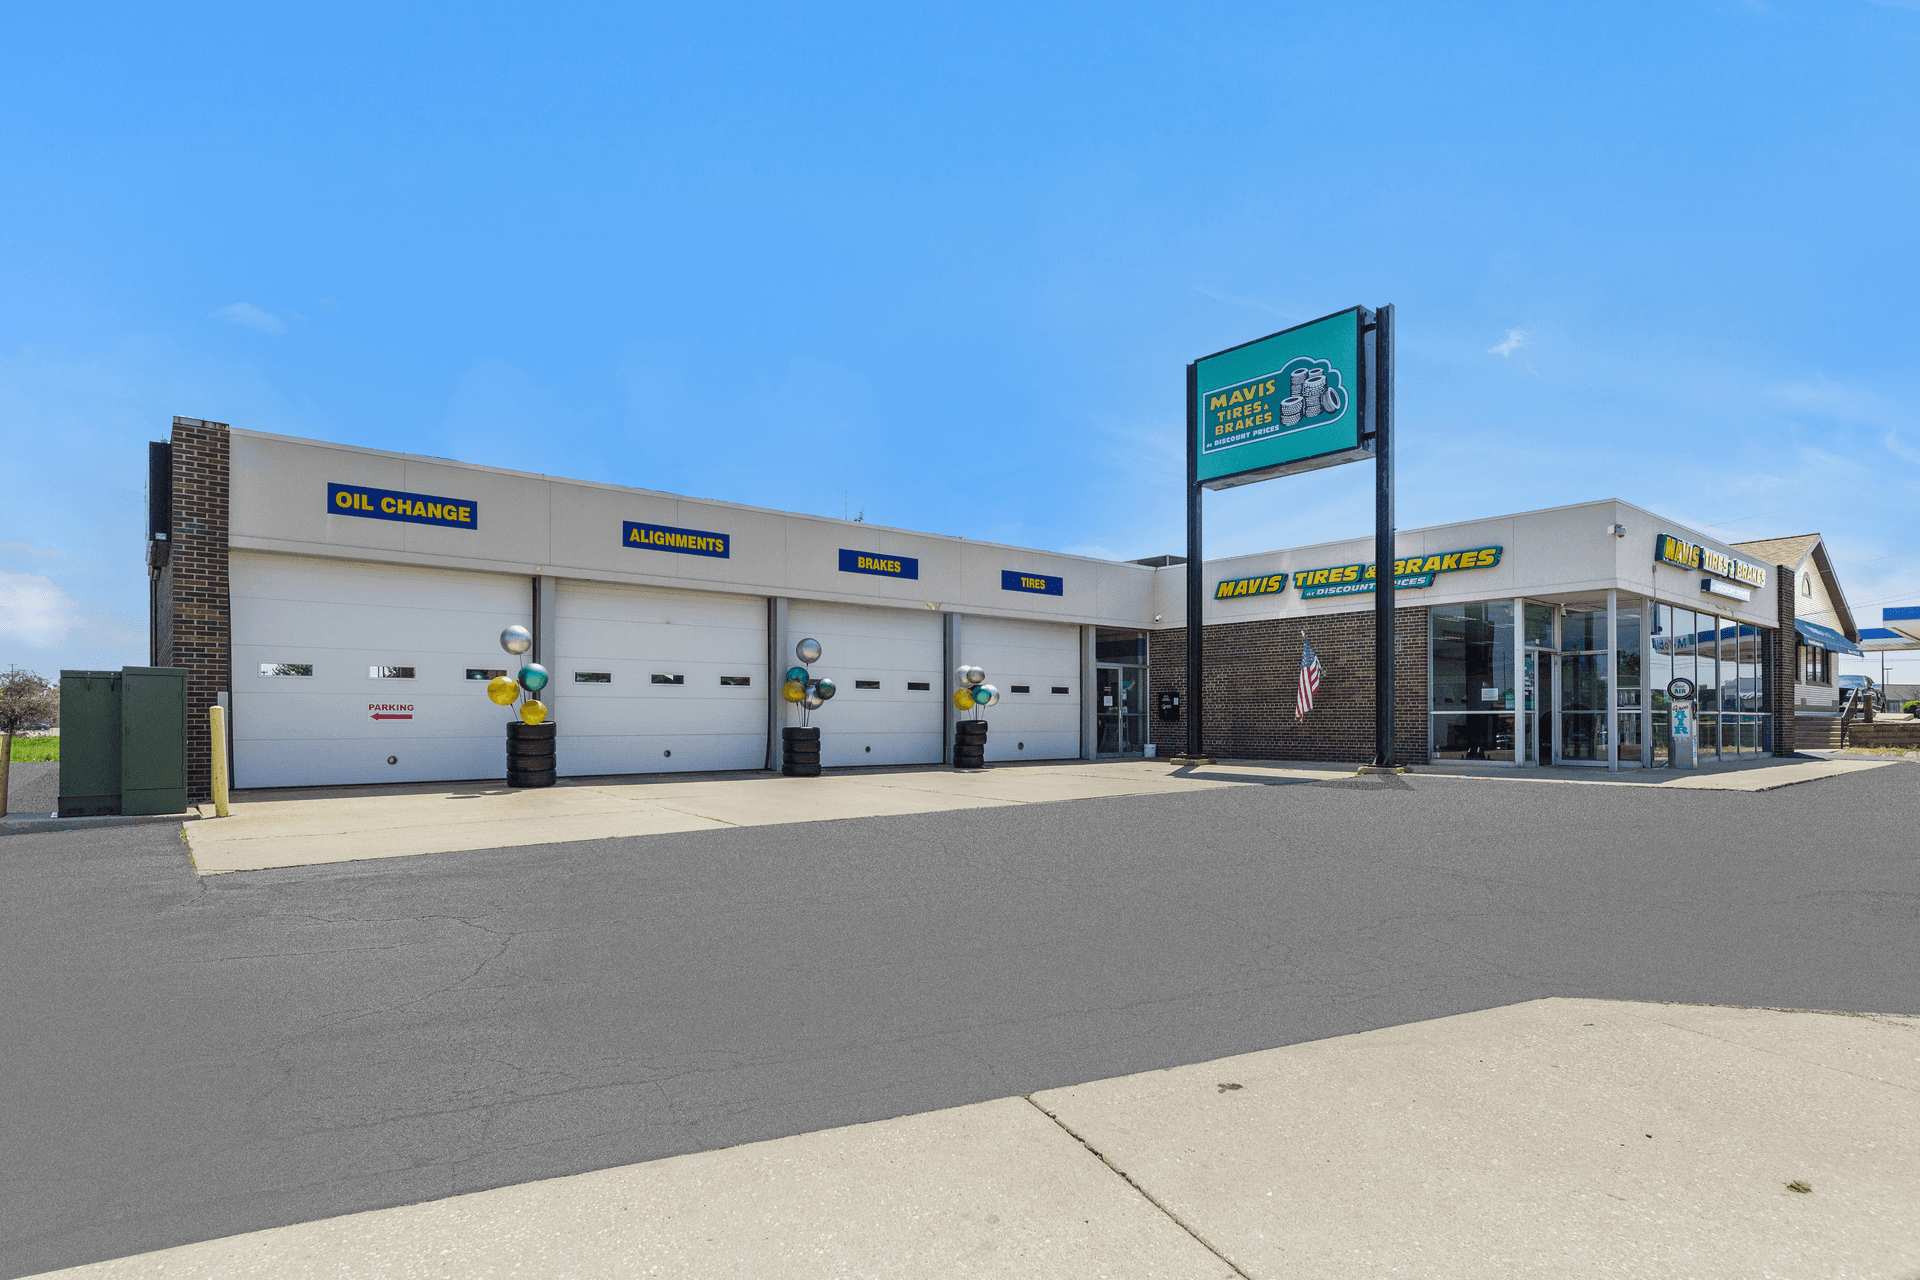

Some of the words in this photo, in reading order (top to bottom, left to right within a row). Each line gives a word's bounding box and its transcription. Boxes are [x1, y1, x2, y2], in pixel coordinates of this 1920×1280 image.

[1210, 379, 1276, 411] MAVIS
[1217, 401, 1262, 422] TIRES
[1214, 432, 1250, 446] DISCOUNT
[1252, 424, 1280, 437] PRICES
[1215, 412, 1272, 436] BRAKES
[335, 491, 374, 511] OIL
[380, 497, 471, 522] CHANGE
[629, 528, 724, 552] ALIGNMENTS
[857, 556, 901, 573] BRAKES
[1217, 575, 1283, 598] MAVIS
[1295, 565, 1360, 587] TIRES
[1364, 565, 1376, 579] &
[1394, 548, 1497, 575] BRAKES
[1664, 536, 1700, 569] MAVIS
[1703, 550, 1728, 577] TIRES
[1736, 562, 1766, 587] BRAKES
[1020, 577, 1046, 590] TIRES
[1316, 582, 1376, 596] DISCOUNT
[368, 703, 415, 712] PARKING
